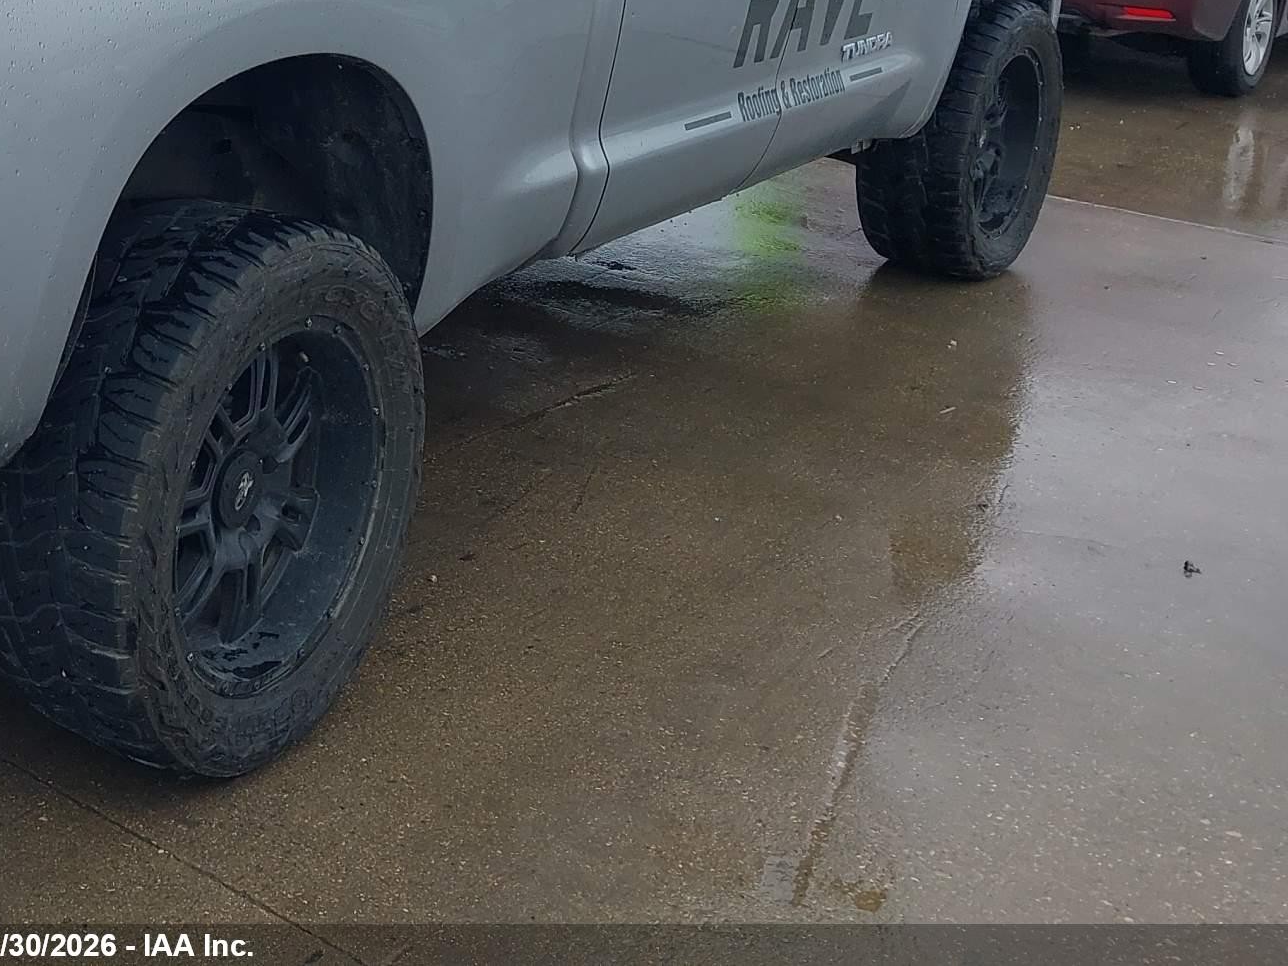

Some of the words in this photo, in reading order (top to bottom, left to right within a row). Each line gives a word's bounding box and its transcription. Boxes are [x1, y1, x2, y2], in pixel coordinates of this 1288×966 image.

[840, 30, 894, 63] TUNDRA
[737, 85, 783, 123] Roofing
[780, 80, 792, 109] &
[790, 67, 846, 107] Restoration
